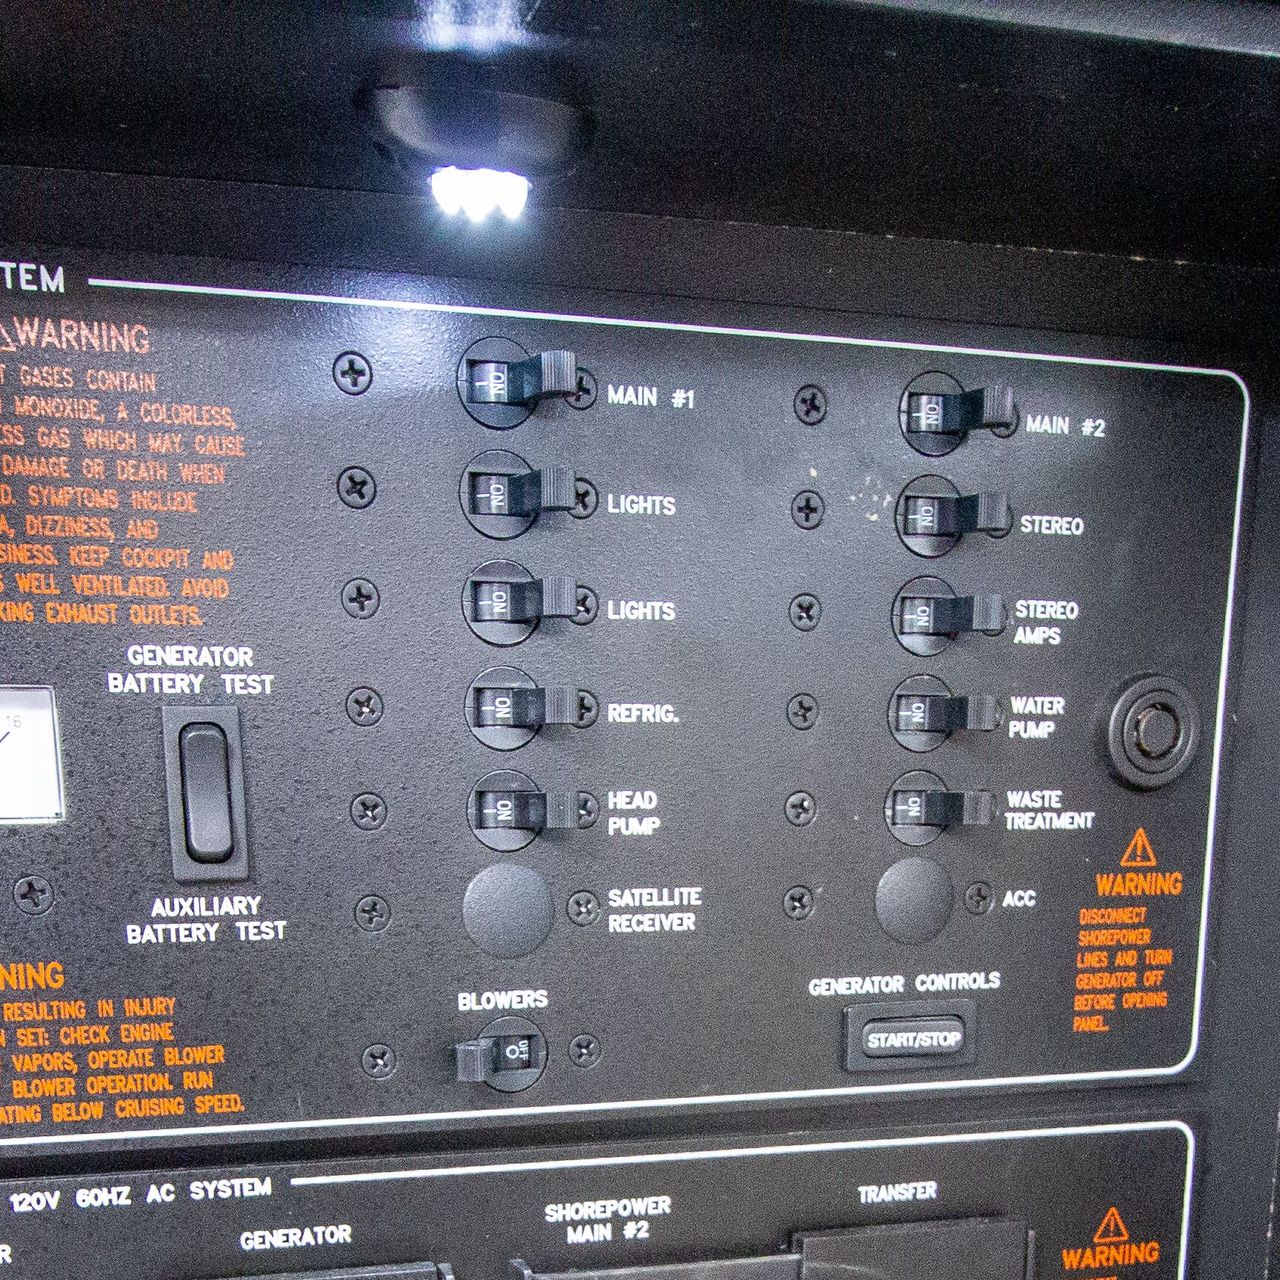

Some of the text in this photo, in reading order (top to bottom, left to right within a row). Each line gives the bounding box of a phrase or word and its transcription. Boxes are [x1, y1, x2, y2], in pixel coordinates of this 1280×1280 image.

[13, 316, 151, 353] WARNING
[608, 385, 694, 408] MAIN #1
[1026, 414, 1105, 437] MAIN #2
[608, 494, 676, 515] LIGHTS
[1021, 515, 1084, 535] STEREO
[16, 572, 60, 595] WELL
[181, 579, 227, 597] AVOID
[45, 602, 117, 623] EXHAUST
[608, 600, 675, 620] LIGHTS
[1016, 600, 1079, 619] STEREO
[1014, 626, 1060, 644] AMPS
[128, 644, 253, 666] GENERATOR
[108, 672, 274, 695] BATTERY TEST
[608, 703, 679, 722] REFRIG.
[1011, 696, 1065, 715] WATER
[1009, 720, 1055, 738] PUMP
[608, 790, 657, 809] HEAD
[1007, 790, 1062, 808] WASTE
[608, 816, 661, 835] PUMP
[1005, 811, 1095, 830] TREATMENT
[1097, 872, 1182, 895] WARNING
[151, 896, 261, 916] AUXILIARY
[609, 887, 702, 907] SATELLITE
[1002, 889, 1036, 907] ACC
[127, 920, 287, 944] BATTERY TEST
[609, 912, 695, 932] RECEIVER
[809, 972, 1000, 995] GENERATOR CONTROLS
[3, 1000, 86, 1021] RESULTING
[98, 999, 114, 1017] IN
[124, 997, 175, 1016] INJURY
[458, 989, 548, 1010] BLOWERS
[59, 1024, 109, 1045] CHECK
[120, 1022, 174, 1042] ENGINE
[868, 1031, 961, 1047] START/STOP
[52, 1101, 103, 1122] BELOW
[115, 1097, 184, 1117] CRUISING
[10, 1191, 60, 1212] 120V
[76, 1186, 131, 1207] 60HZ
[147, 1183, 175, 1203] AC
[190, 1177, 271, 1199] SYSTEM
[858, 1181, 937, 1202] TRANSFER
[545, 1196, 671, 1221] SHOREPOWER
[240, 1225, 351, 1249] GENERATOR
[567, 1220, 649, 1243] MAIN #2
[1062, 1242, 1159, 1268] WARNING
